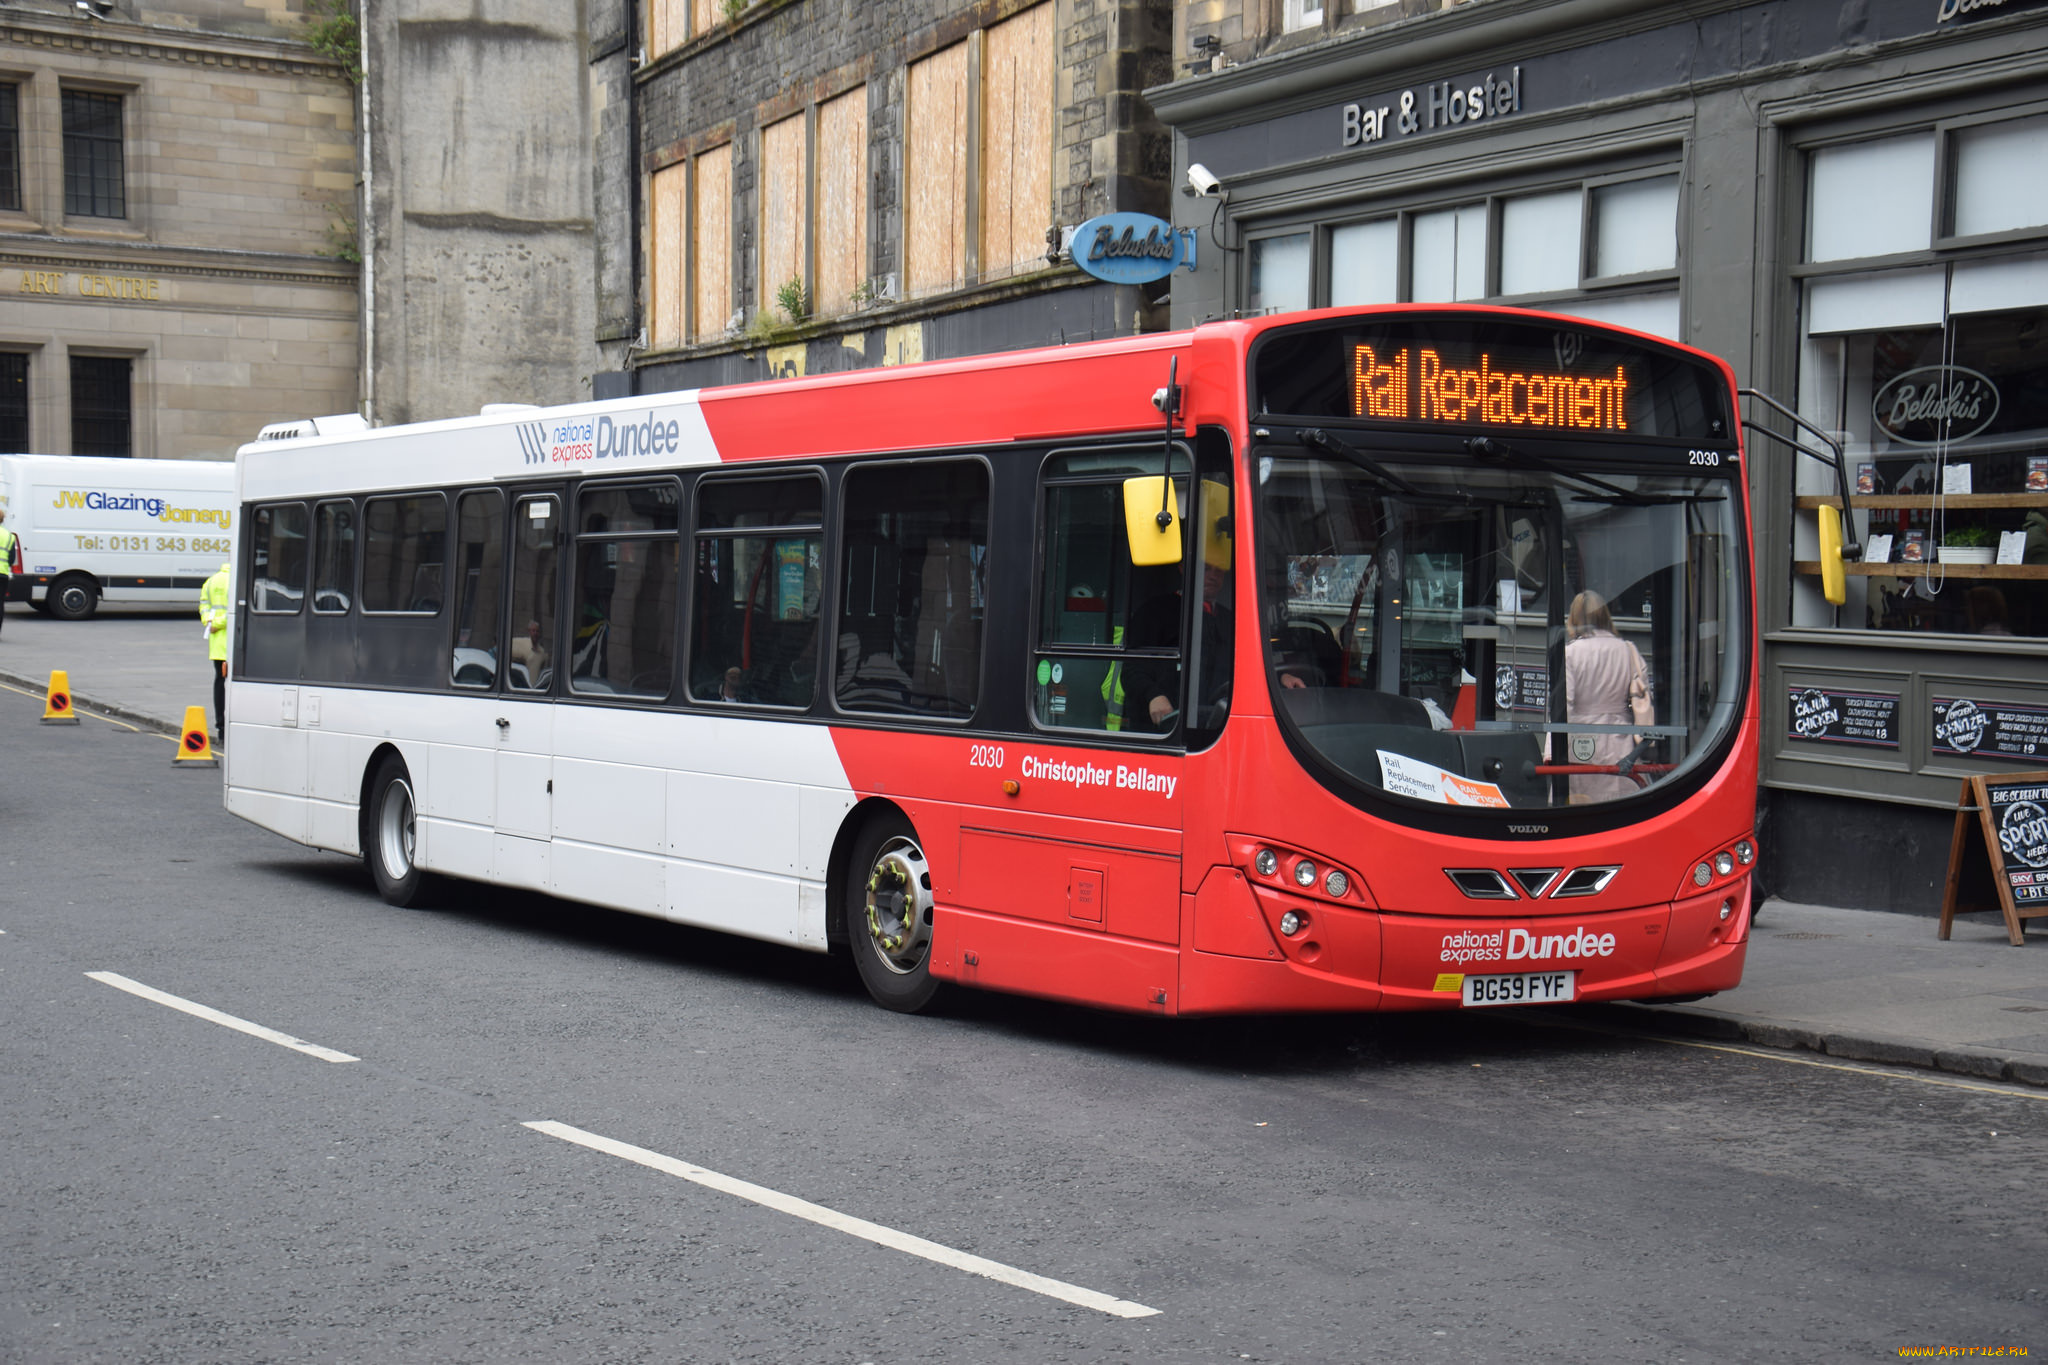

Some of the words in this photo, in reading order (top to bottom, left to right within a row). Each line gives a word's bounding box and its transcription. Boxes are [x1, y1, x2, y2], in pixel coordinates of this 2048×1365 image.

[1343, 104, 1389, 146] Bar
[1397, 90, 1418, 135] &
[1428, 66, 1520, 128] Hostel
[20, 271, 63, 295] ART
[79, 274, 160, 300] CENTRE
[1355, 345, 1408, 418] Rail
[1420, 349, 1627, 430] Replacement
[1888, 380, 1982, 425] Belushi's
[552, 416, 595, 444] national
[596, 410, 679, 459] Dundee
[552, 442, 593, 468] express
[1688, 450, 1719, 467] 2030
[159, 504, 231, 530] Joinery
[74, 536, 104, 550] Tel:
[109, 536, 149, 551] 0131
[156, 537, 186, 552] 343
[191, 538, 231, 553] 6642
[1795, 696, 1830, 716] CAJUN
[1795, 709, 1839, 732] CHICKEN
[970, 745, 1004, 768] 2030
[1384, 757, 1402, 769] Rail
[1021, 755, 1113, 788] Christopher
[1115, 765, 1177, 799] Bellany
[1387, 769, 1436, 793] Replacement
[1388, 780, 1418, 798] Service
[1460, 784, 1481, 796] RAIL
[1992, 791, 2009, 804] BIG
[2009, 788, 2039, 802] SCREEN
[2013, 808, 2031, 823] LIVE
[1507, 824, 1549, 834] VOLVO
[2026, 844, 2048, 859] HERE
[2012, 874, 2031, 884] SKY
[2028, 886, 2042, 898] BT
[1442, 929, 1503, 949] national
[1506, 926, 1616, 960] Dundee
[1440, 947, 1502, 966] express
[1473, 976, 1524, 1001] BG59
[1529, 974, 1566, 999] FYF
